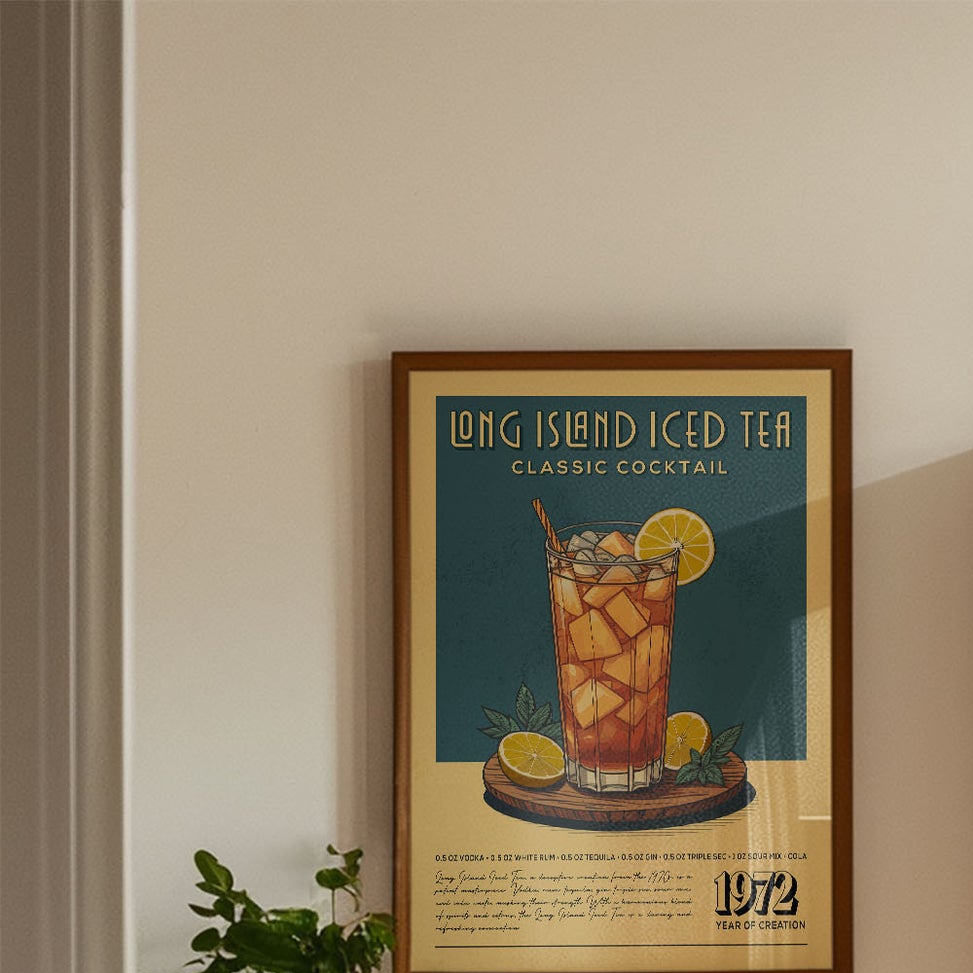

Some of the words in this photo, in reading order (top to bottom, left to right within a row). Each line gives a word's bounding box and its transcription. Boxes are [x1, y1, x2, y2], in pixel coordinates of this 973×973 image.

[450, 410, 521, 449] LONG
[536, 410, 637, 449] ISLAND
[650, 410, 726, 449] ICED
[740, 410, 791, 449] TEA
[511, 459, 608, 475] CLASSIC
[616, 459, 729, 475] COCKTAIL
[435, 854, 448, 862] 0.5
[448, 854, 459, 862] OZ
[460, 854, 485, 862] VODKA
[514, 854, 538, 862] WHITE
[560, 853, 573, 861] 0.5
[573, 853, 584, 861] OZ
[585, 853, 616, 861] TEQUILA
[621, 853, 634, 861] 0.5
[634, 853, 645, 861] OZ
[645, 853, 658, 861] GIN
[663, 853, 676, 861] 0.5
[676, 853, 686, 861] OZ
[687, 853, 711, 861] TRIPLE
[712, 853, 727, 861] SEC
[748, 852, 768, 860] SOUR
[787, 852, 808, 860] COLA
[713, 870, 800, 917] 1972
[716, 921, 742, 930] YEAR
[743, 920, 756, 930] OF
[758, 920, 807, 930] CREATION
